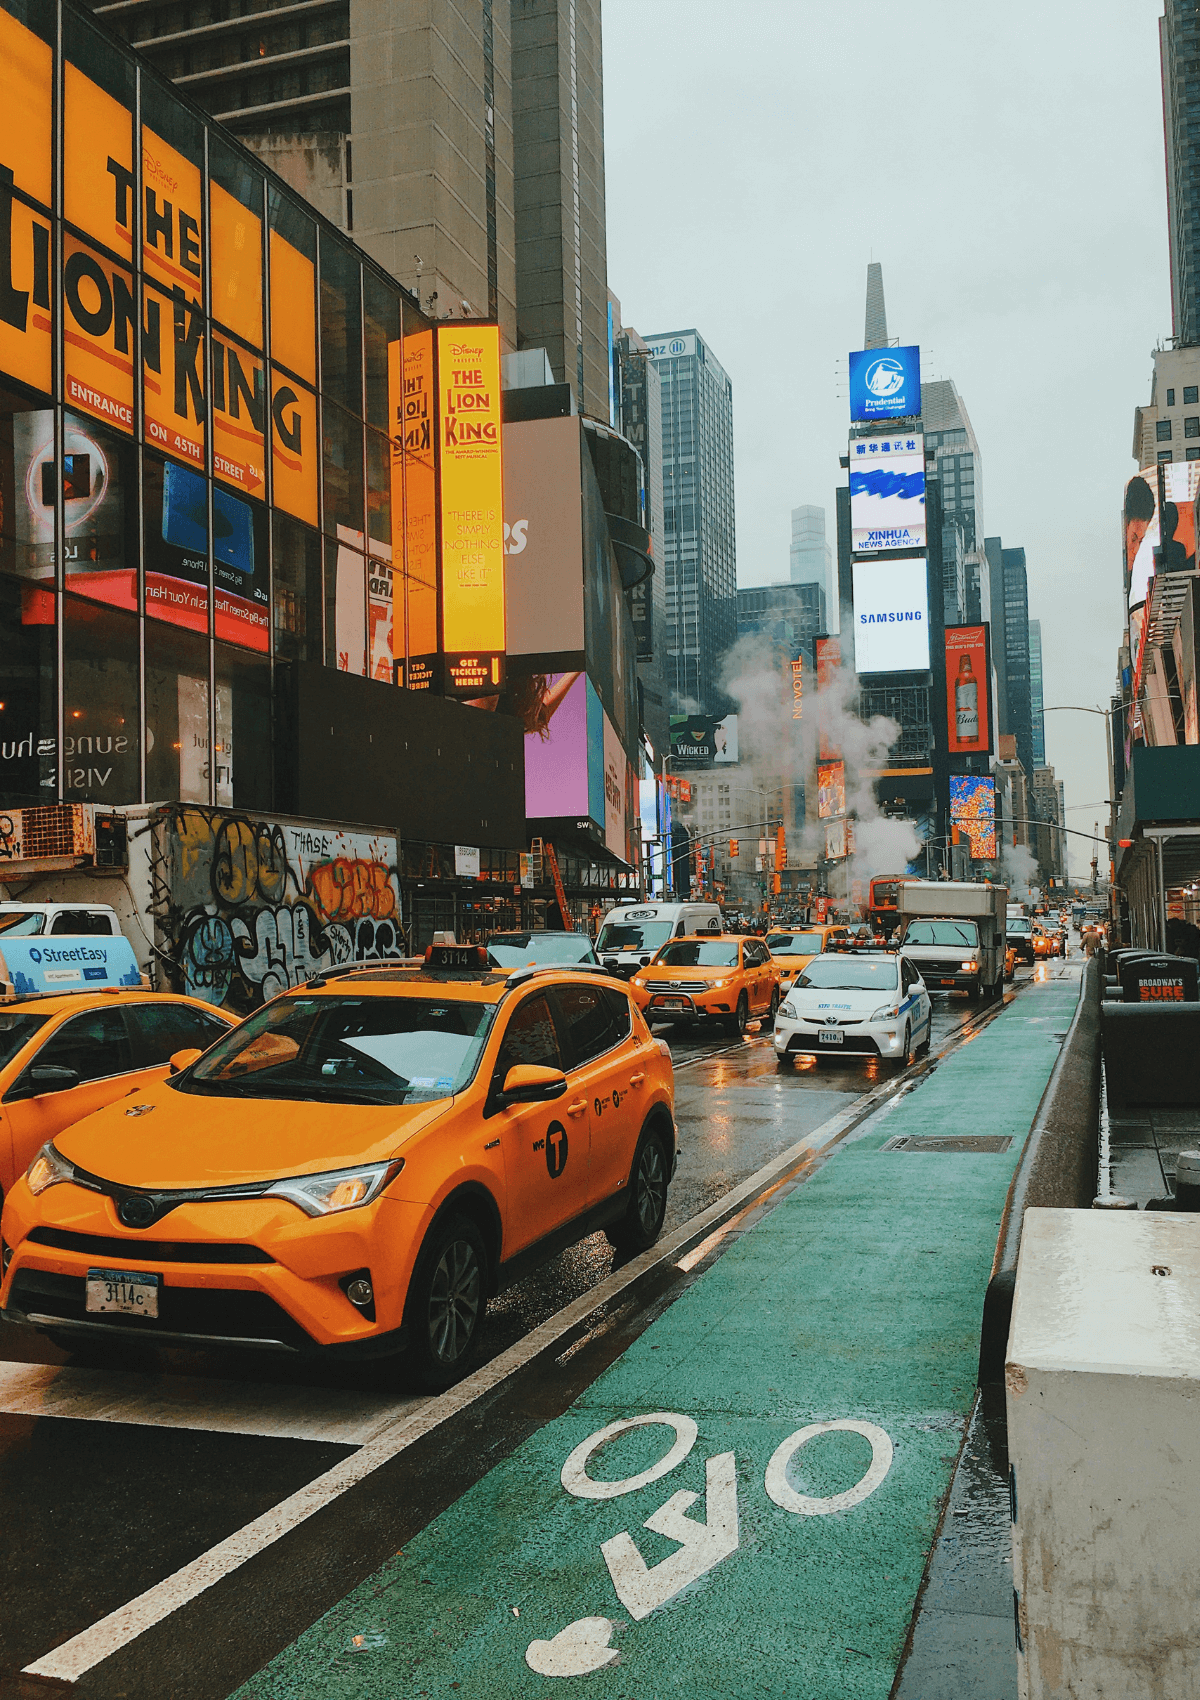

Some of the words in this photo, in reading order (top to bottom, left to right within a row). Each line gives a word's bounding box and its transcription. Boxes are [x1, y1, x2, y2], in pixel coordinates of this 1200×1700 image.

[107, 155, 200, 279] THE
[447, 343, 484, 357] Disney
[172, 283, 303, 457] KING
[451, 370, 482, 385] THE
[447, 388, 490, 415] LION
[865, 396, 906, 407] Prudential
[71, 381, 133, 424] ENTRANCE
[149, 422, 168, 442] ON
[174, 435, 201, 459] 45TH
[214, 456, 245, 481] STREET
[444, 416, 497, 447] KING
[487, 510, 495, 520] IS
[457, 525, 490, 535] SIMPLY
[868, 529, 910, 540] XINHUA
[445, 539, 500, 549] NOTHING
[858, 541, 883, 549] NEWS
[885, 538, 920, 547] AGENCY
[462, 554, 483, 564] ELSE
[458, 569, 475, 579] LIKE
[860, 611, 922, 624] SAMSUNG
[460, 659, 478, 667] GET
[450, 668, 488, 676] TICKETS
[455, 678, 483, 686] HERE!
[792, 655, 803, 720] NOVOTEL
[42, 947, 107, 963] StreetEasy
[441, 950, 468, 965] 3T14
[1138, 978, 1183, 987] BROADWAY'S
[1139, 986, 1184, 997] SURE
[532, 1138, 545, 1152] NYC
